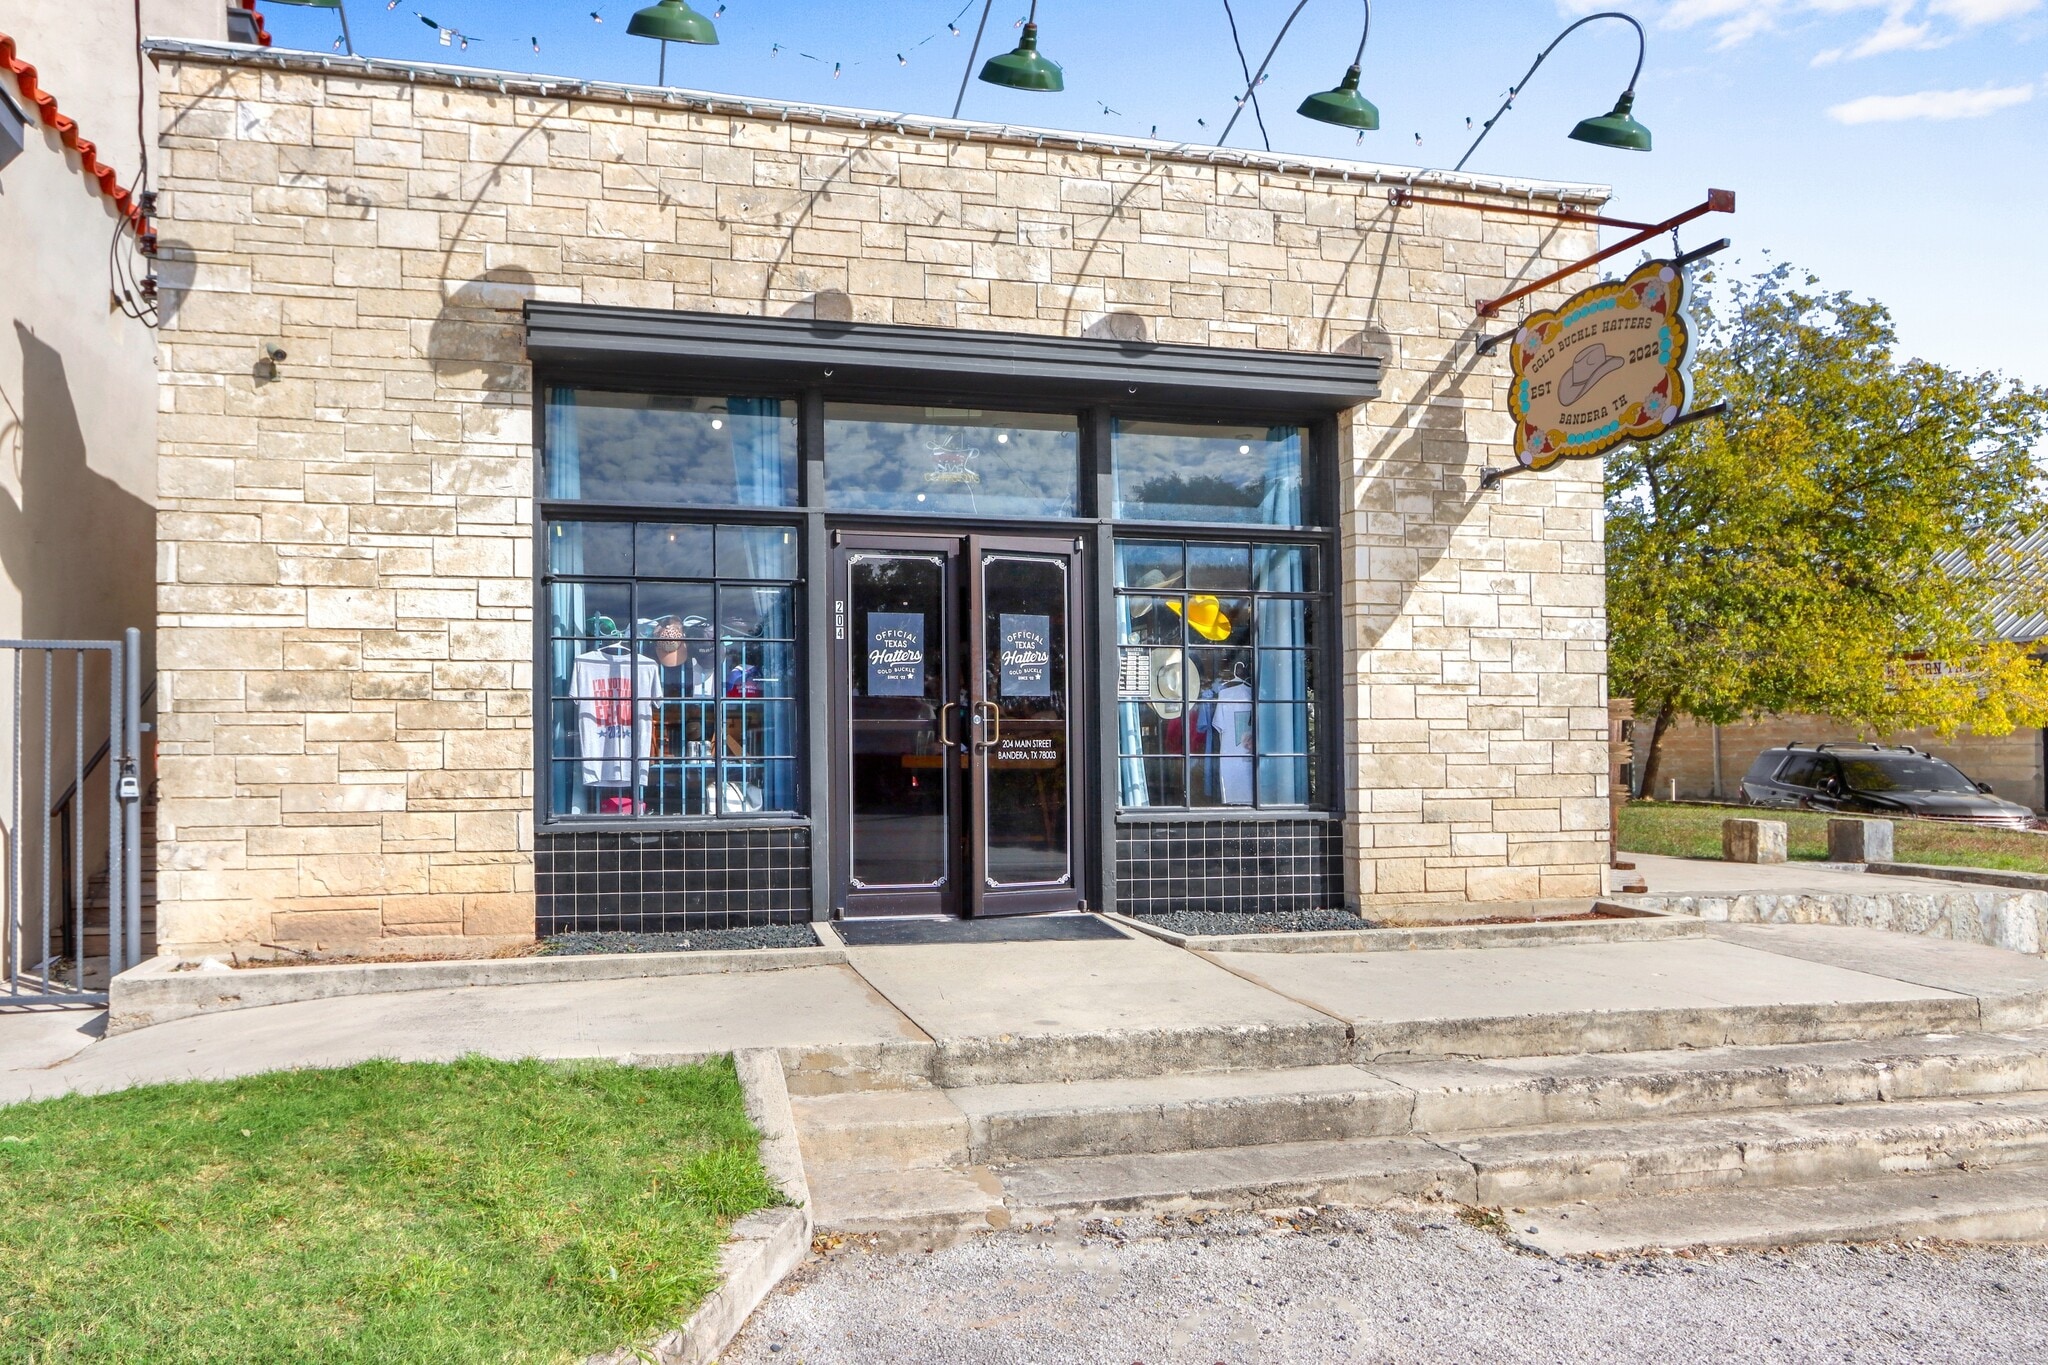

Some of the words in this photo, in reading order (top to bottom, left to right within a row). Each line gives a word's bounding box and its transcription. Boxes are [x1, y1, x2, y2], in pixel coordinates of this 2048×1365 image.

[1531, 347, 1555, 374] GOLD
[1558, 324, 1597, 352] BUCKLE
[1602, 317, 1653, 333] HATTERS
[1629, 341, 1659, 364] 2022
[1531, 381, 1552, 400] EST
[1559, 406, 1609, 425] BANDERA
[875, 630, 917, 644] OFFICIAL
[884, 639, 908, 648] TEXAS
[1006, 631, 1044, 645] OFFICIAL
[1015, 641, 1036, 650] TEXAS
[869, 649, 923, 667] Hatters
[1002, 650, 1049, 668] Hatters
[592, 679, 605, 690] I'M
[608, 677, 632, 689] VOTIN
[1002, 740, 1014, 748] 204
[1014, 740, 1032, 748] MAIN
[1032, 740, 1052, 748] STREET
[997, 751, 1030, 760] BANDERA,
[1030, 751, 1038, 760] TX
[1038, 751, 1057, 760] 78003
